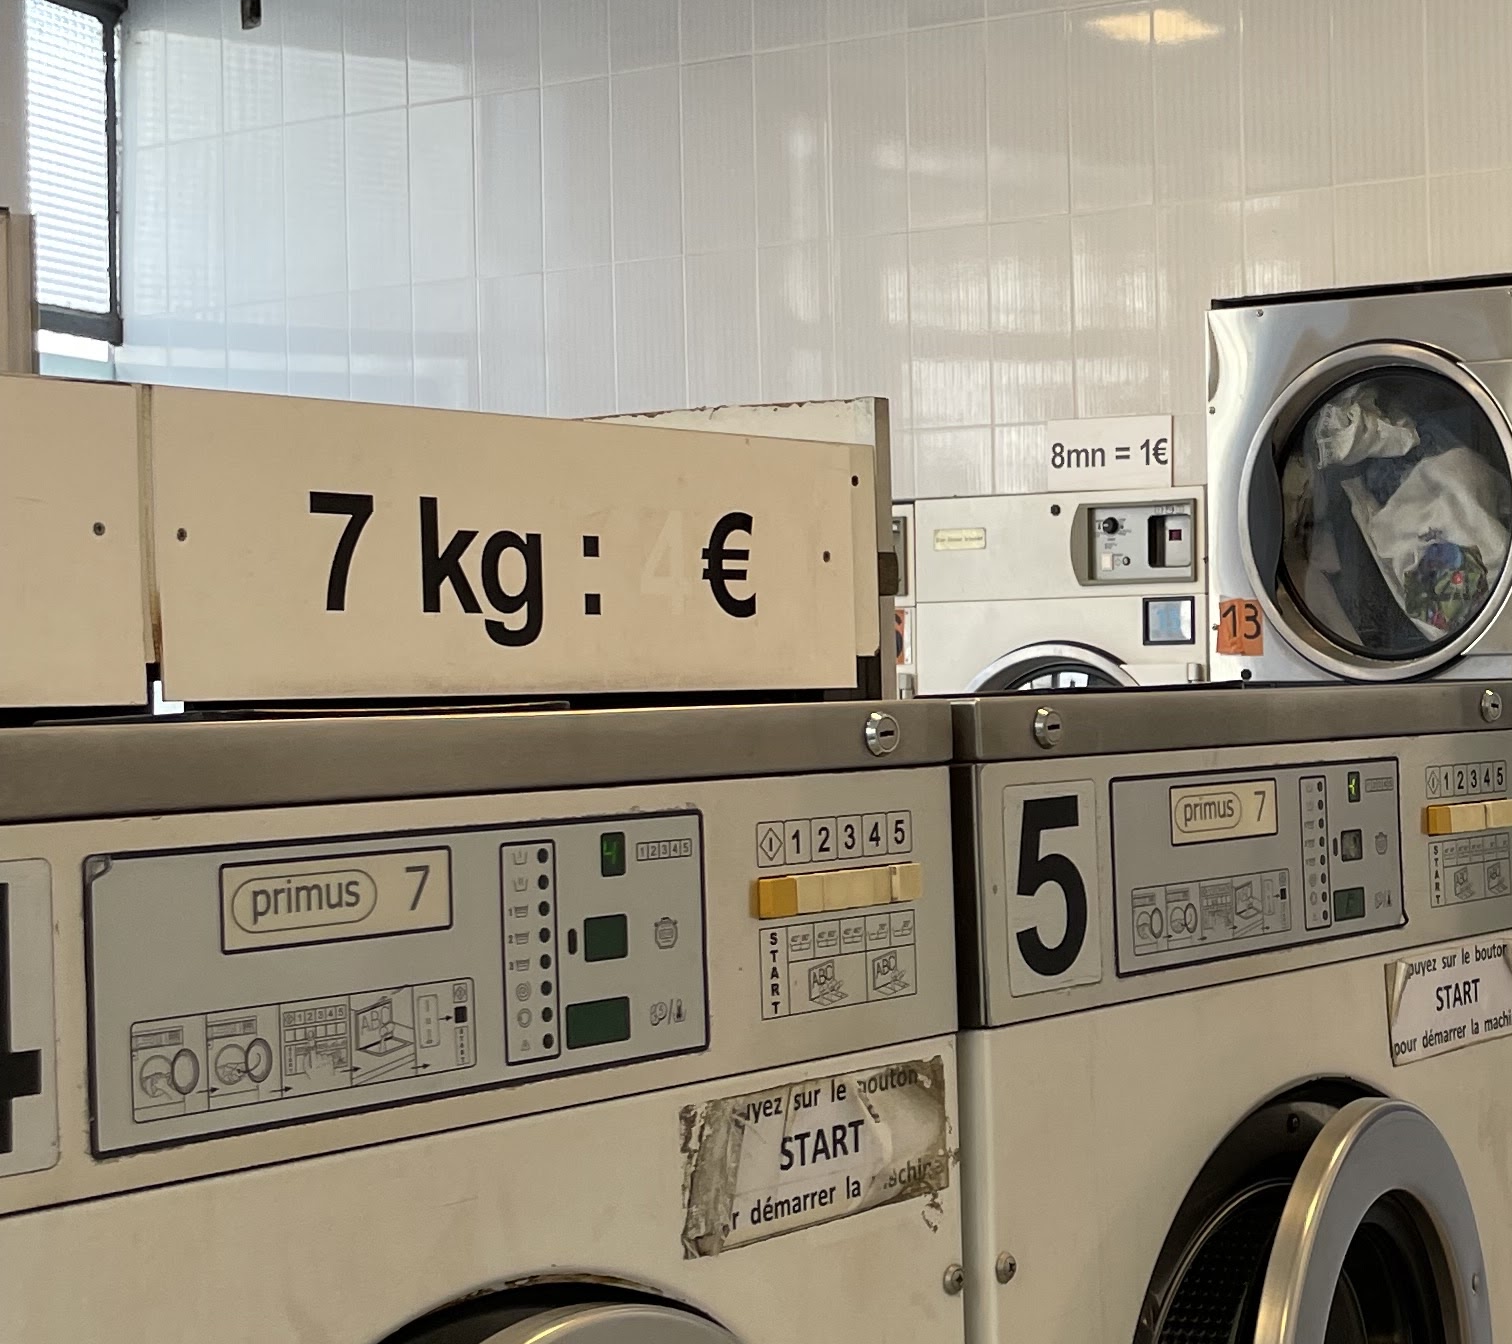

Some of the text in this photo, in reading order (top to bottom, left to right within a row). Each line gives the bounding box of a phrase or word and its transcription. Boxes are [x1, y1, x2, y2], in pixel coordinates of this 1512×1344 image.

[1050, 442, 1106, 468] 8mn
[1139, 437, 1169, 466] 1€
[308, 491, 374, 612] 7
[420, 496, 544, 648] kg
[701, 511, 757, 618] €
[1222, 603, 1262, 641] 13
[1443, 766, 1504, 790] 1 2 3 4 5
[1184, 790, 1267, 827] primus 7
[791, 819, 905, 855] 1 2 3 4 5
[1016, 794, 1088, 977] 5
[1433, 845, 1442, 905] START
[252, 865, 431, 925] primus 7
[769, 932, 781, 1015] START
[812, 964, 834, 988] ABC
[1442, 954, 1457, 969] sur
[1461, 948, 1470, 965] le
[1436, 978, 1480, 1012] START
[1394, 1038, 1417, 1056] pour
[1422, 1023, 1466, 1049] démarrer
[1471, 1018, 1480, 1035] la
[793, 1087, 821, 1111] sur
[831, 1078, 847, 1103] le
[779, 1119, 864, 1171] START
[750, 1185, 836, 1226] démarrer
[846, 1175, 861, 1200] la
